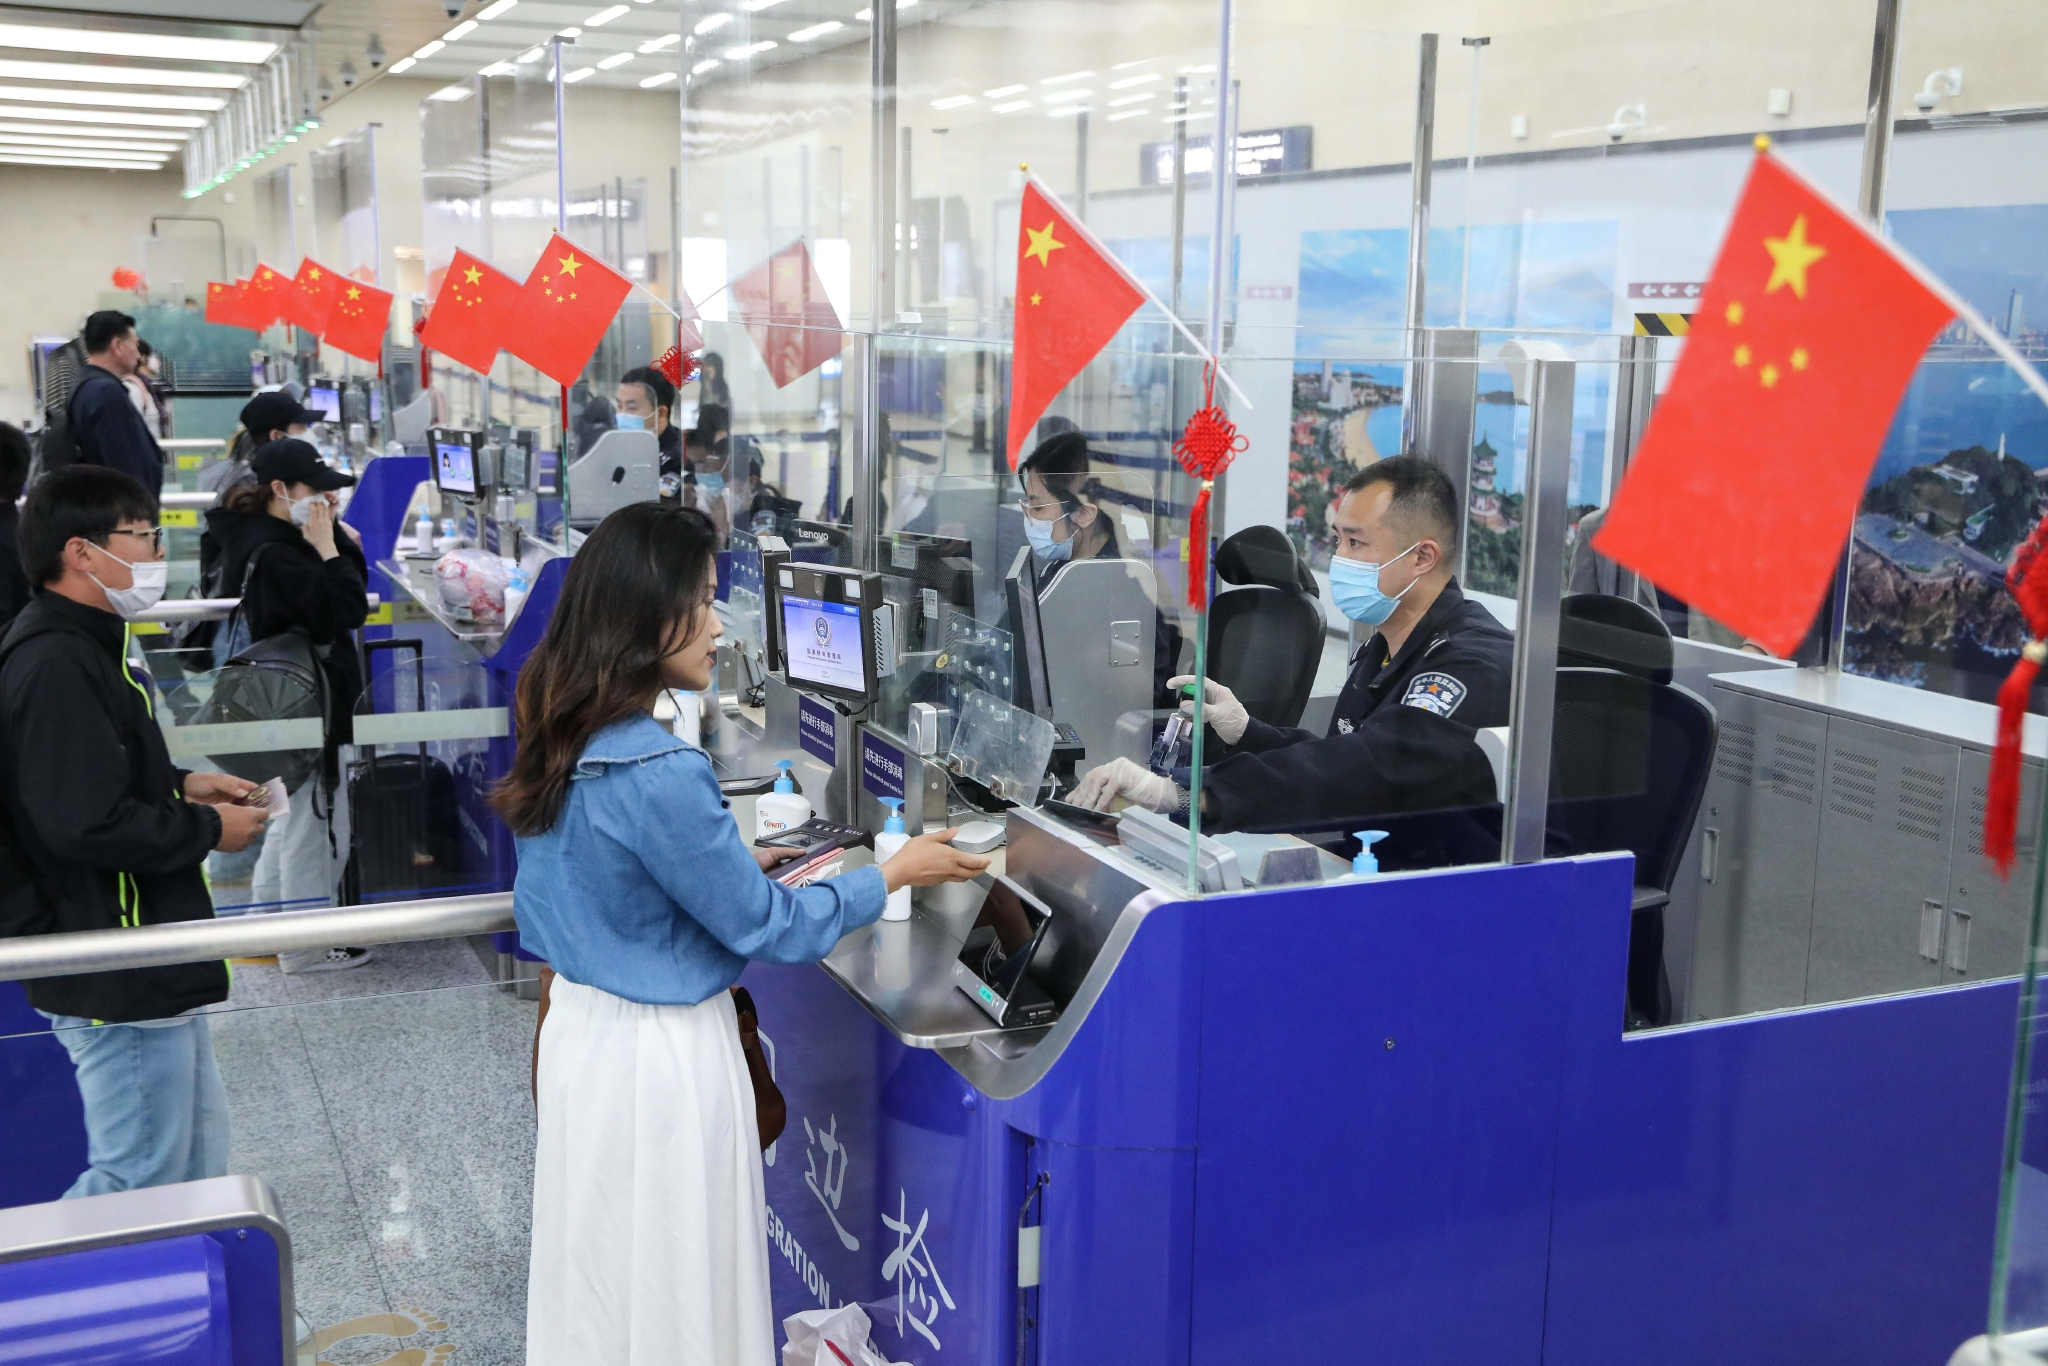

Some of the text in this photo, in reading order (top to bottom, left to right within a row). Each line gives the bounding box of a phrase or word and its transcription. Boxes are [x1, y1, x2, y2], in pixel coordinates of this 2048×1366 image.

[798, 527, 829, 541] Lenovo
[864, 746, 903, 781] 请先进行手部消毒
